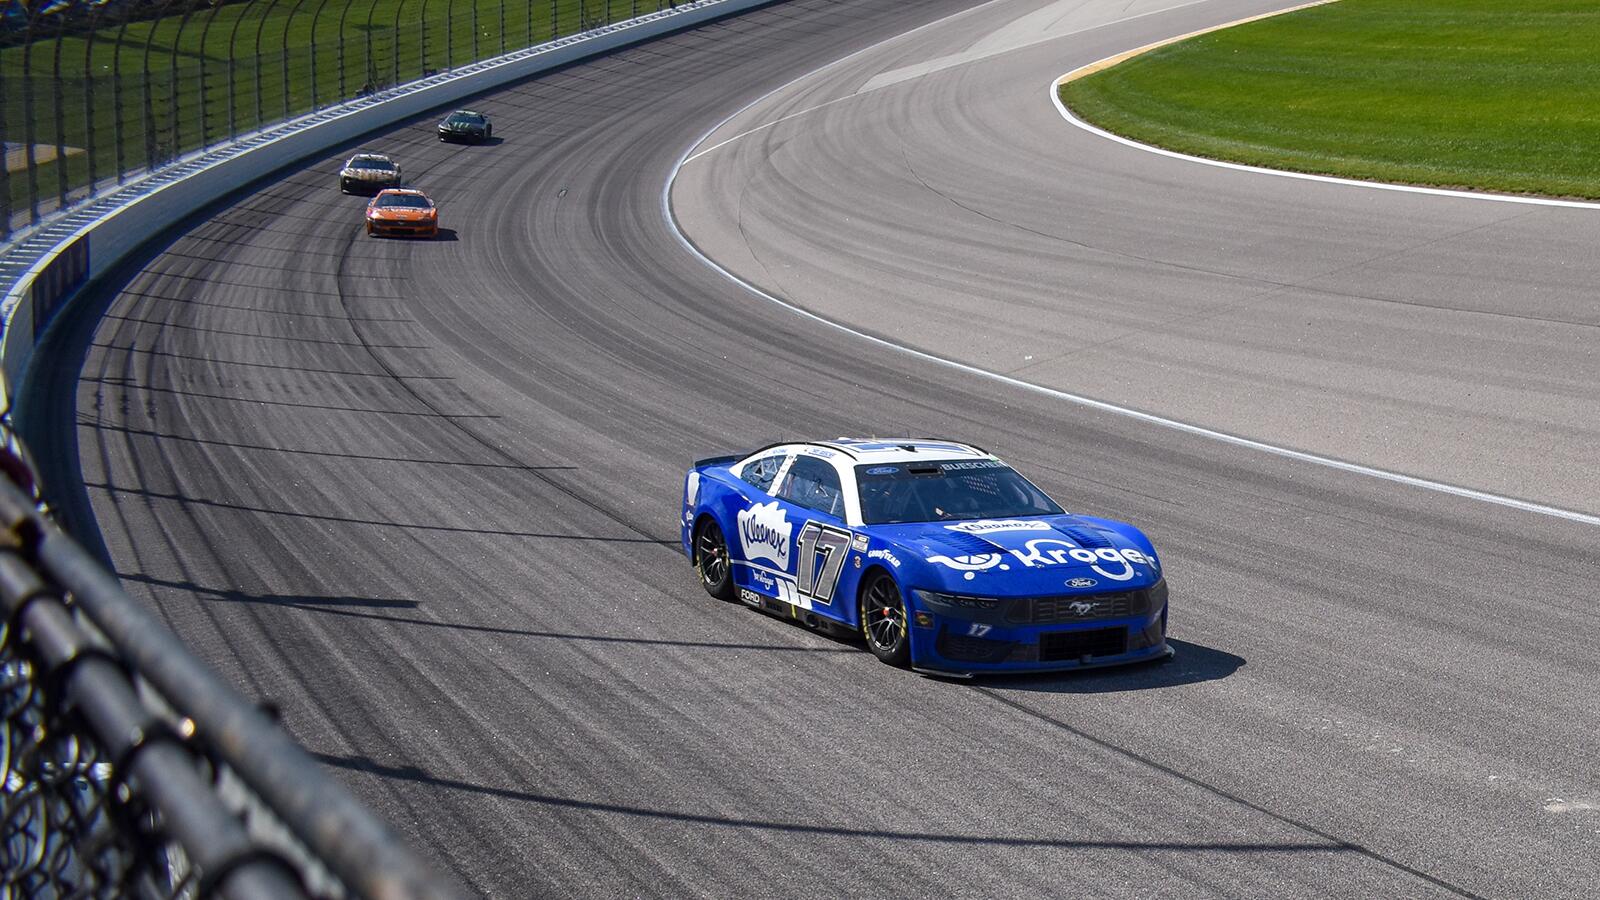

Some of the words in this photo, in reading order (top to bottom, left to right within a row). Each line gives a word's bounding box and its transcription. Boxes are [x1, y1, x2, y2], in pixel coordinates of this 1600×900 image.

[742, 514, 787, 559] Kleenex
[797, 519, 853, 606] 17
[868, 549, 901, 568] GOODYEAR
[1009, 539, 1156, 581] Kroger
[741, 589, 760, 603] FORD
[967, 622, 992, 637] 17
